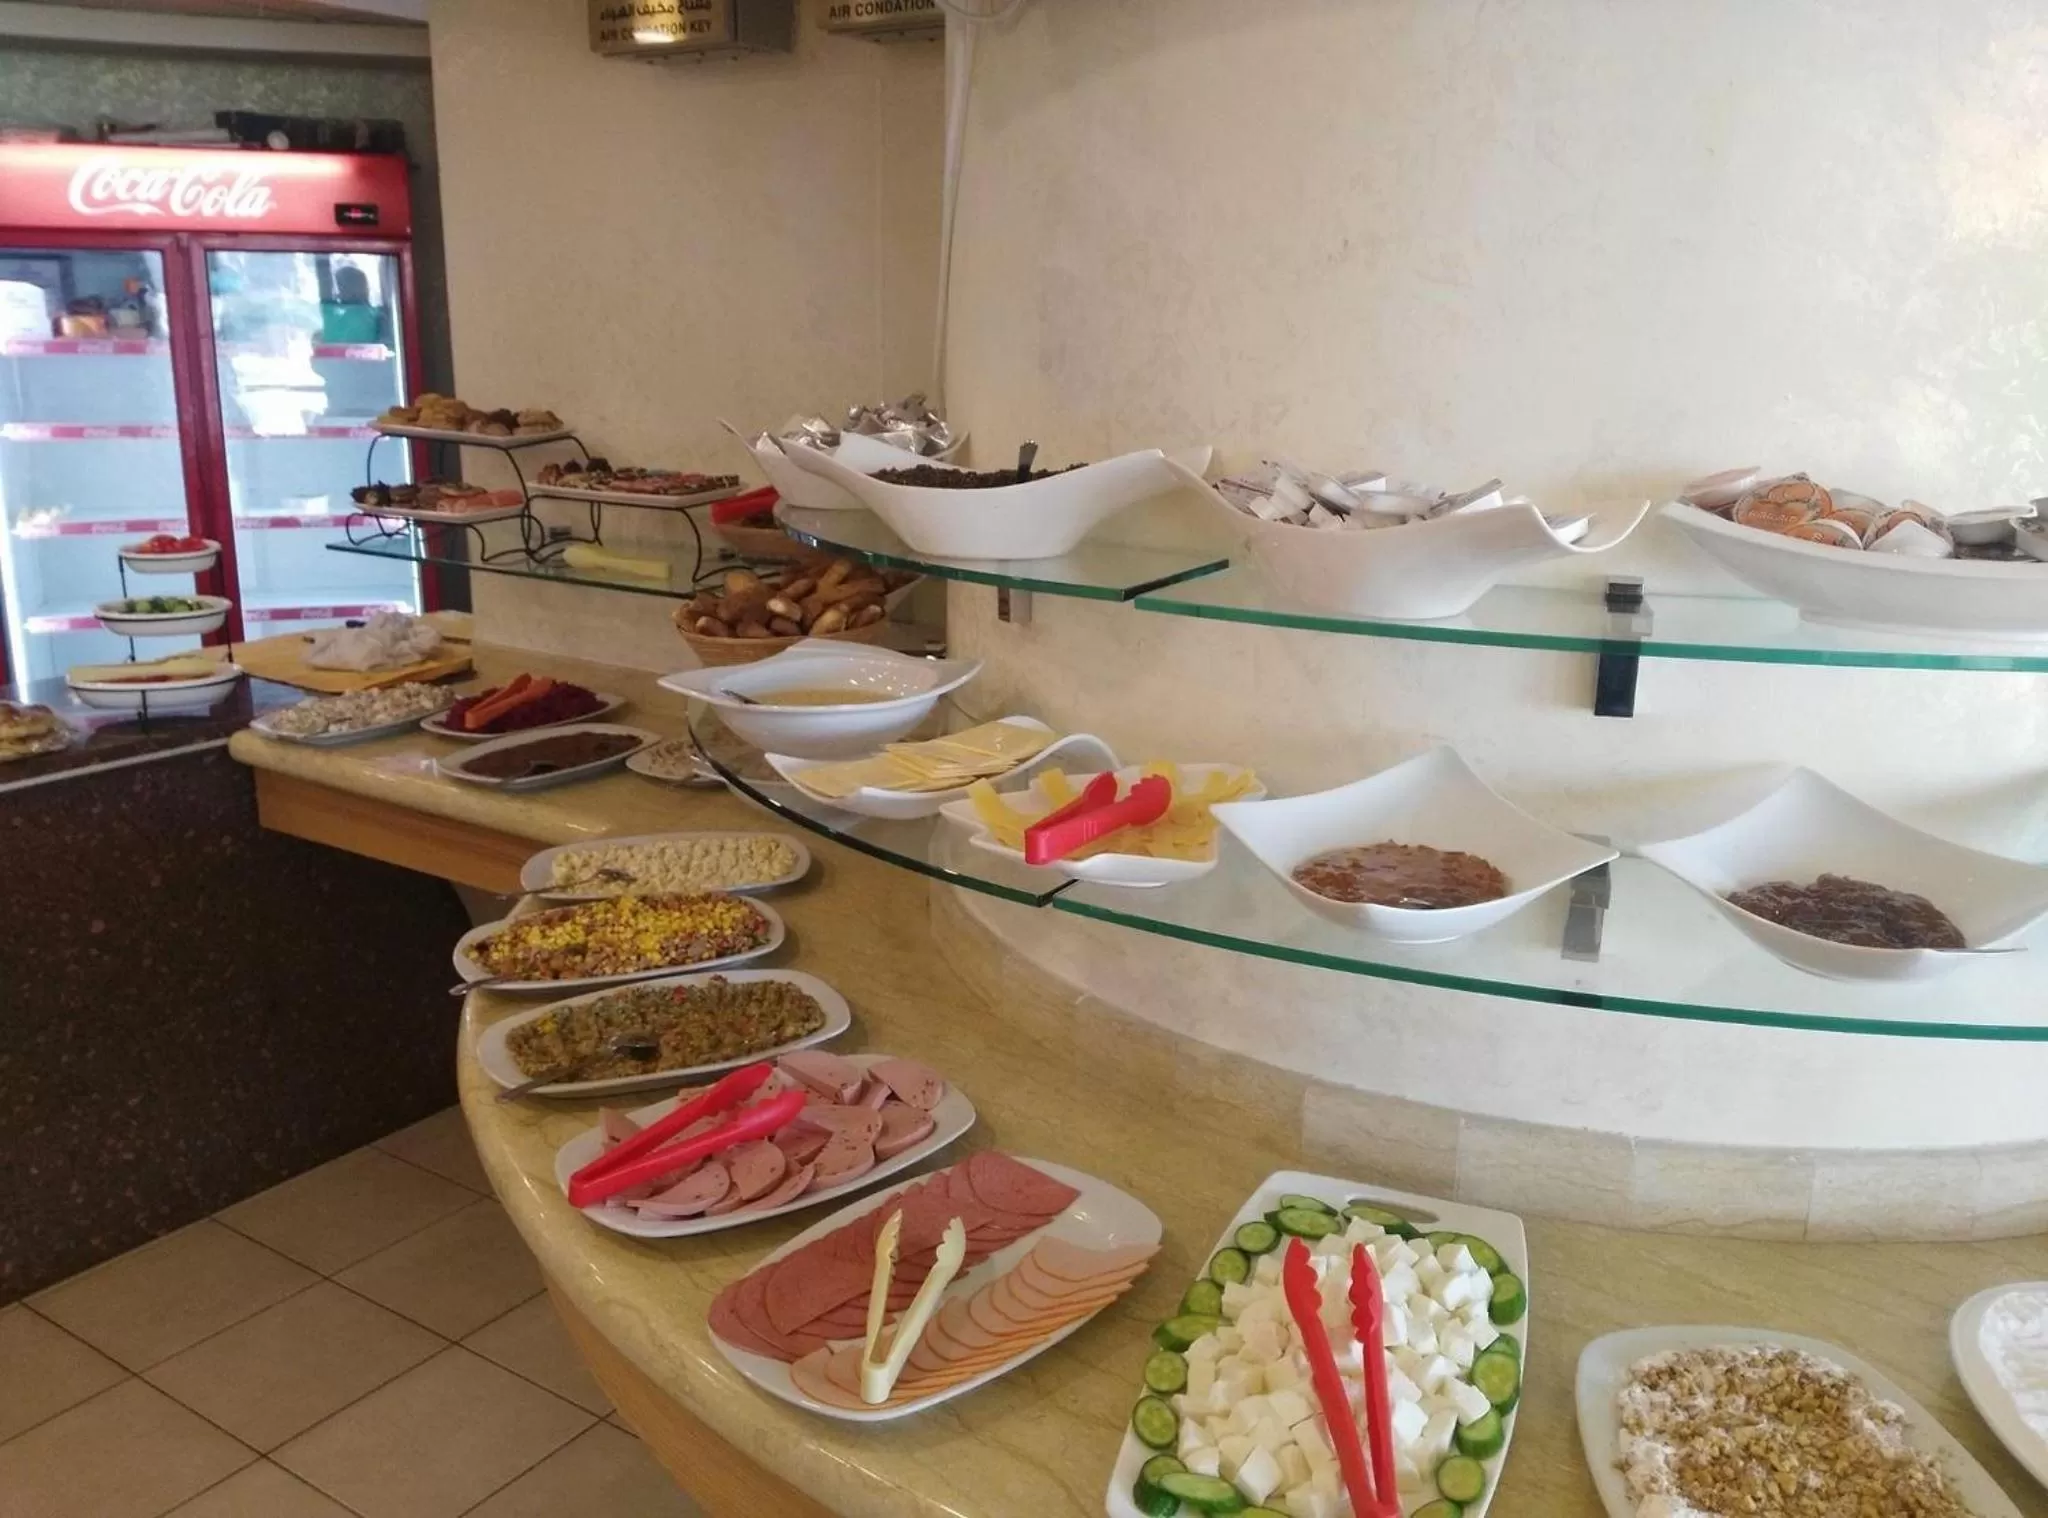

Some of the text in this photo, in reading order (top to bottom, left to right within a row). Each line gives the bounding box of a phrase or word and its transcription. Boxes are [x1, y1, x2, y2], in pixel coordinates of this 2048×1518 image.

[828, 4, 852, 19] AIR
[600, 27, 619, 42] AIR
[690, 19, 713, 33] KEY
